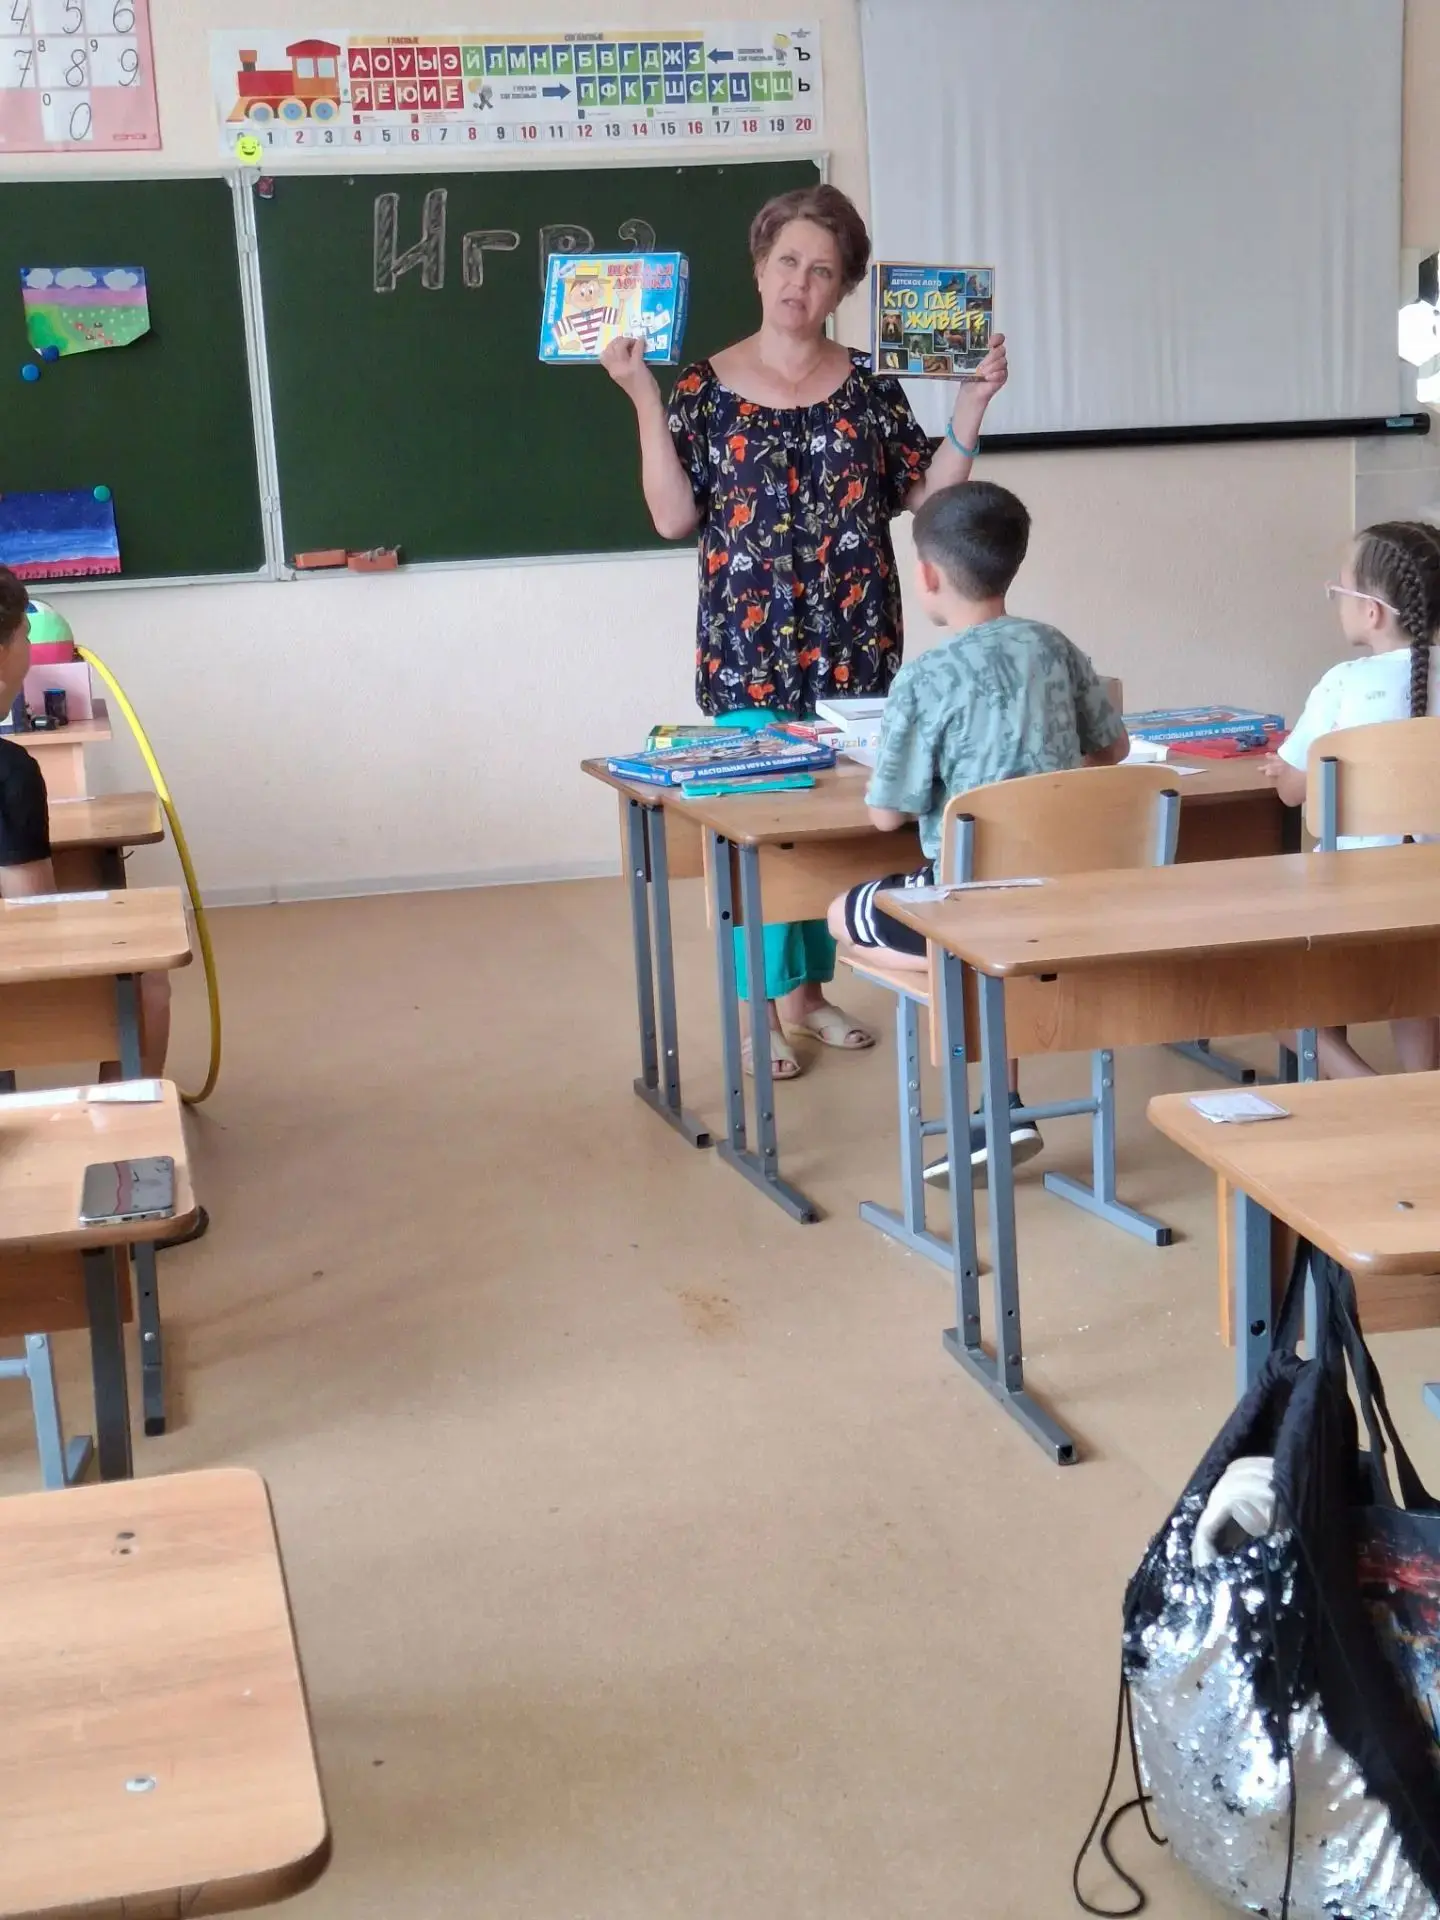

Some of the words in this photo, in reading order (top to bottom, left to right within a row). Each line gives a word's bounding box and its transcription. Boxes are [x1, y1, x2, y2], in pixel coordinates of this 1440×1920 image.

[11, 0, 30, 35] 4
[62, 0, 83, 34] 5
[113, 0, 136, 33] 6
[37, 39, 46, 52] 8
[65, 49, 87, 88] 8
[90, 39, 99, 52] 9
[117, 48, 139, 86] 9
[793, 46, 811, 61] Ъ
[14, 50, 32, 88] 7
[798, 77, 810, 92] Ь
[267, 132, 273, 144] 1
[295, 130, 304, 144] 2
[324, 130, 333, 143] 3
[353, 130, 362, 142] 4
[382, 129, 391, 142] 5
[411, 128, 420, 142] 6
[440, 128, 448, 141] 7
[468, 127, 477, 140] 8
[496, 126, 505, 139] 9
[521, 126, 537, 139] 10
[549, 126, 563, 138] 11
[577, 124, 592, 137] 12
[605, 124, 620, 136] 13
[632, 123, 648, 136] 14
[661, 122, 676, 135] 15
[688, 121, 703, 134] 16
[715, 121, 730, 133] 17
[742, 120, 757, 133] 18
[769, 119, 785, 131] 19
[795, 118, 811, 131] 20
[883, 289, 918, 309] КТО
[924, 290, 959, 311] ГДЕ
[831, 736, 867, 749] Puzzle
[697, 763, 747, 776] НАСТОЛЬНАЯ
